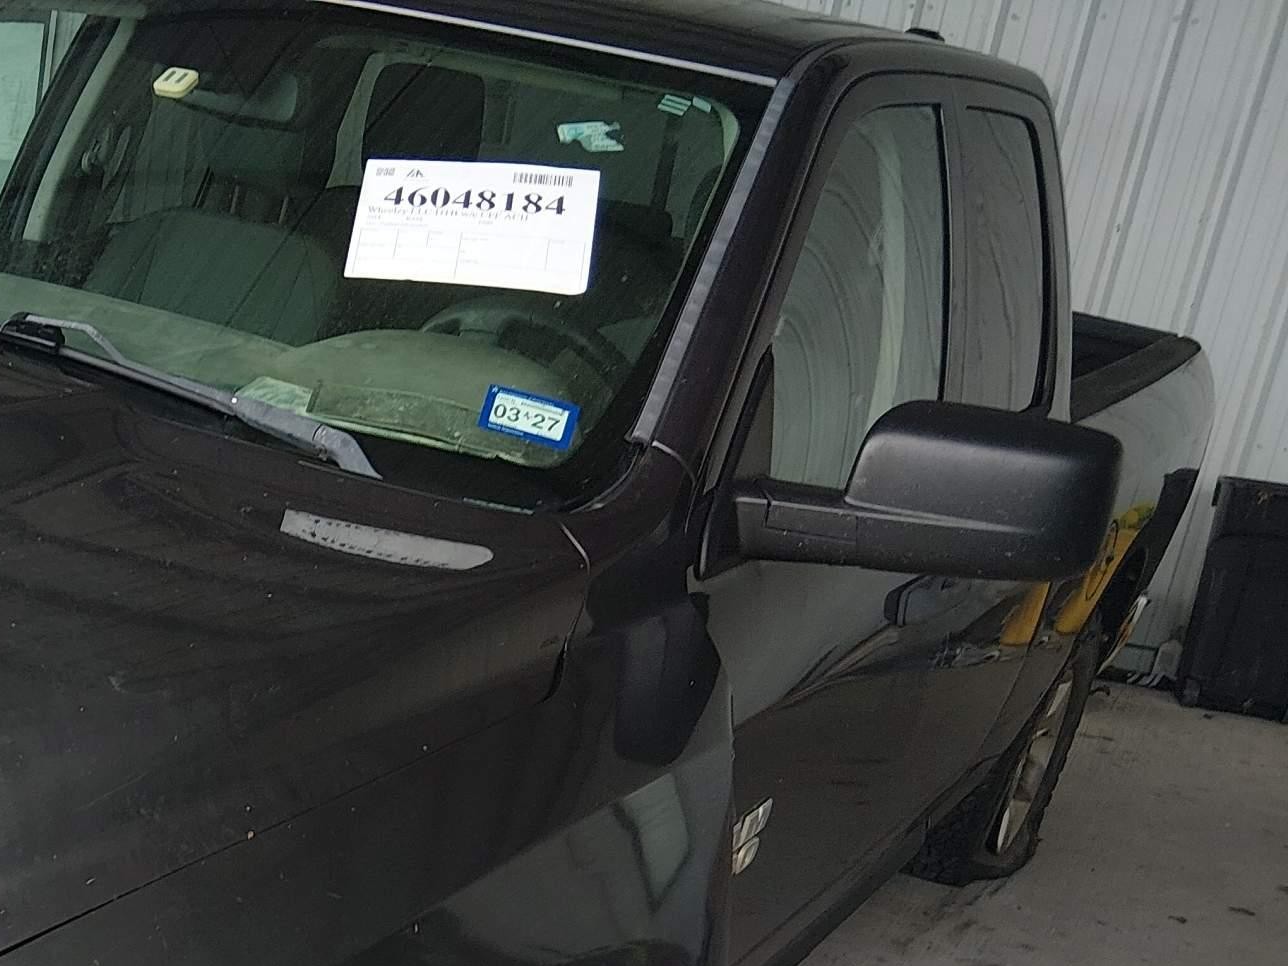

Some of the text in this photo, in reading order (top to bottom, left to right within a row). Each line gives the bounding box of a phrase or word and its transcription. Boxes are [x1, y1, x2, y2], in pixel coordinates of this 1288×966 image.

[383, 186, 567, 216] 46048184
[493, 403, 521, 423] 03
[531, 413, 561, 432] 27
